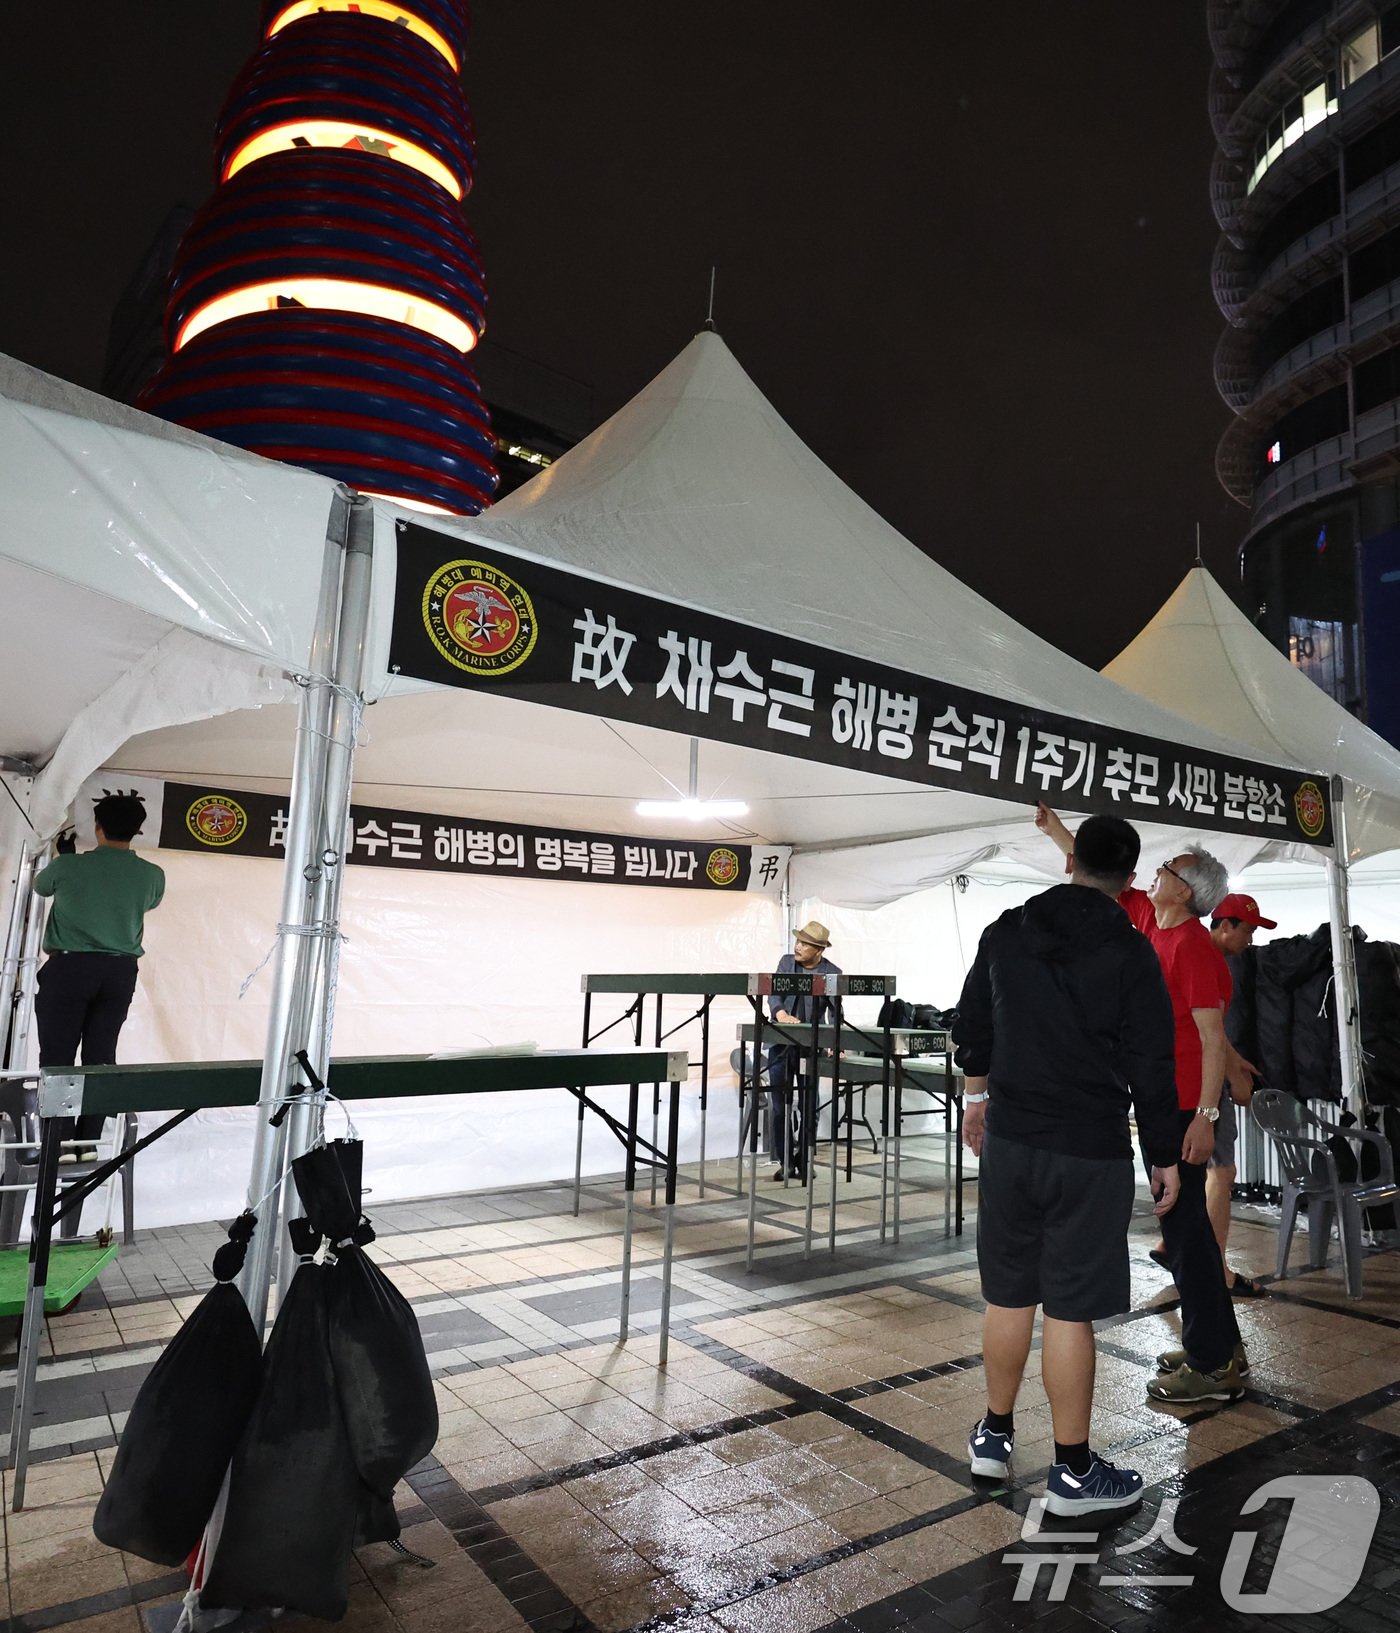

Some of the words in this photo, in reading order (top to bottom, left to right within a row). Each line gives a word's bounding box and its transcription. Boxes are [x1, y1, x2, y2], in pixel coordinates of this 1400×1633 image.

[433, 568, 465, 598] 해병대
[470, 567, 511, 592] 예비역
[511, 594, 529, 619] 연대
[451, 647, 499, 667] MARINE
[500, 634, 528, 665] CORPS
[571, 608, 638, 697] 故
[656, 630, 815, 738] 채수근
[832, 676, 919, 760] 해병
[928, 706, 1006, 781] 순직
[1014, 727, 1097, 797] 1주기
[1102, 747, 1160, 806] 추모
[1167, 761, 1217, 816] 시민
[1224, 772, 1287, 826] 분향소
[347, 817, 423, 859] 수근
[434, 827, 525, 868] 해병의
[535, 838, 616, 875] 명복을
[624, 845, 699, 881] 빕니다
[759, 855, 779, 887] 弔
